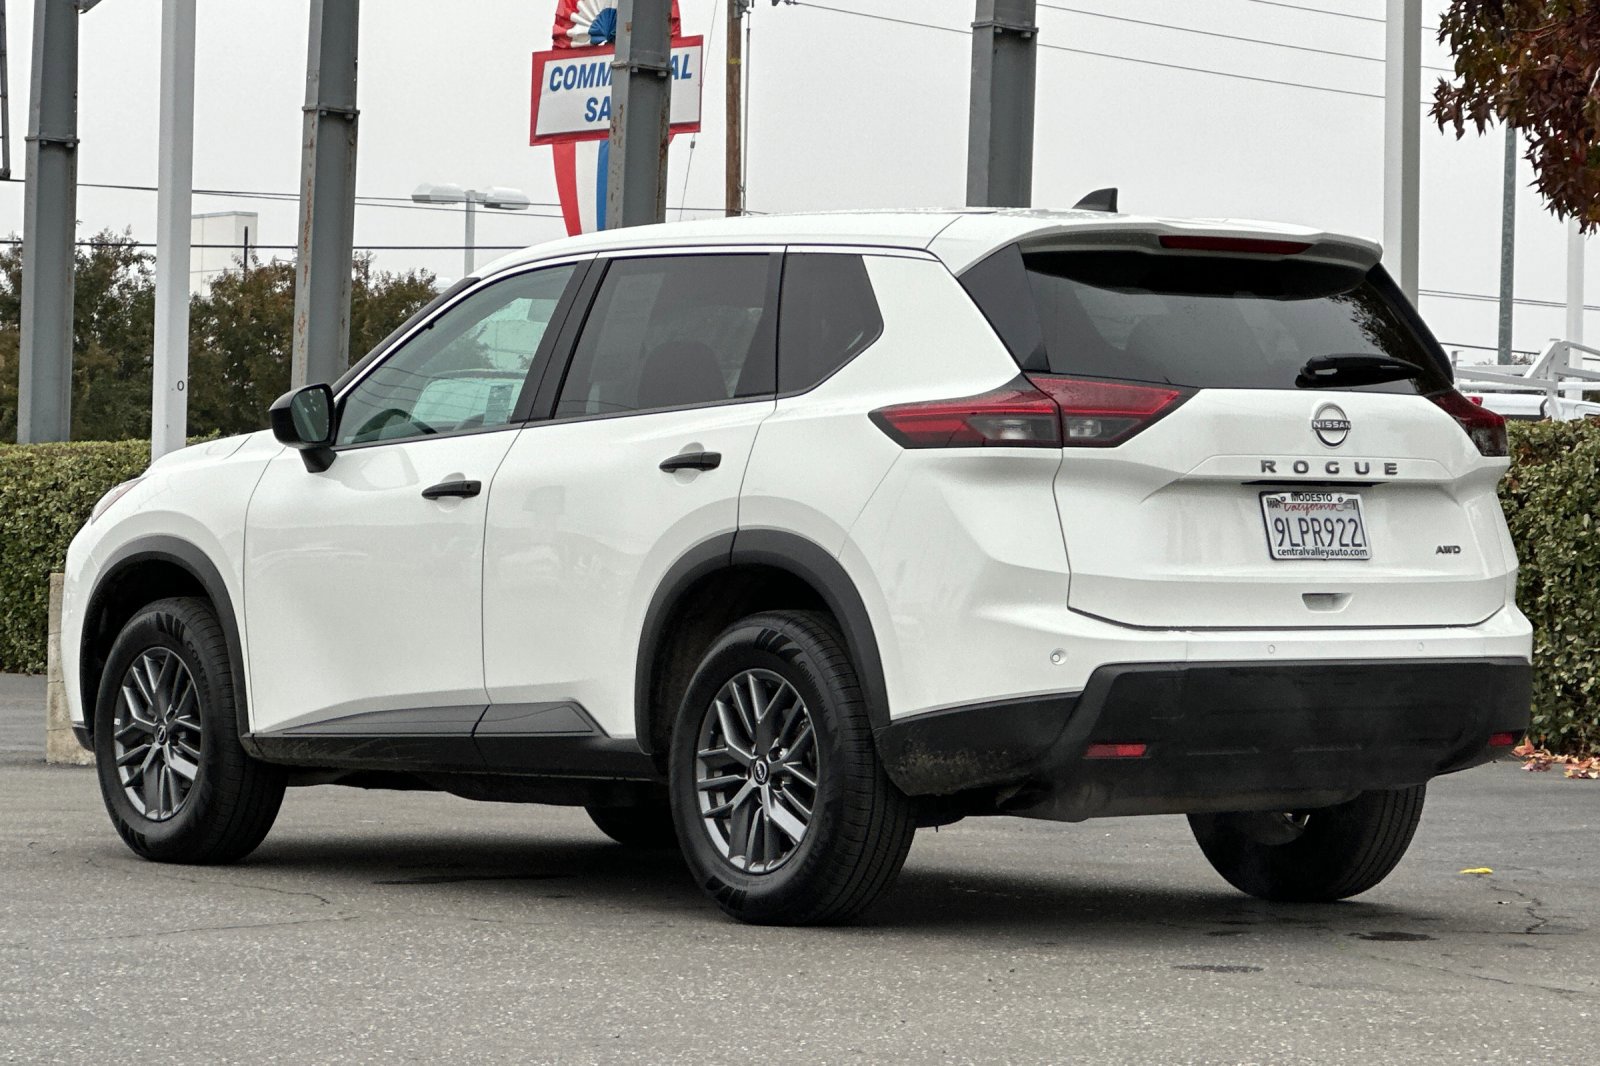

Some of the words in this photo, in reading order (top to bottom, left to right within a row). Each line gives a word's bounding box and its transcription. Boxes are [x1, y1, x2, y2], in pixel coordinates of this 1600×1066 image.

[549, 53, 692, 92] COMMAL
[1312, 419, 1351, 430] NISSAN
[1260, 459, 1398, 475] ROGUE
[1290, 492, 1333, 502] MODESTO
[1274, 517, 1363, 548] 9LPR922
[1277, 547, 1368, 558] centralvalleyauto.com
[1436, 545, 1461, 555] AWD
